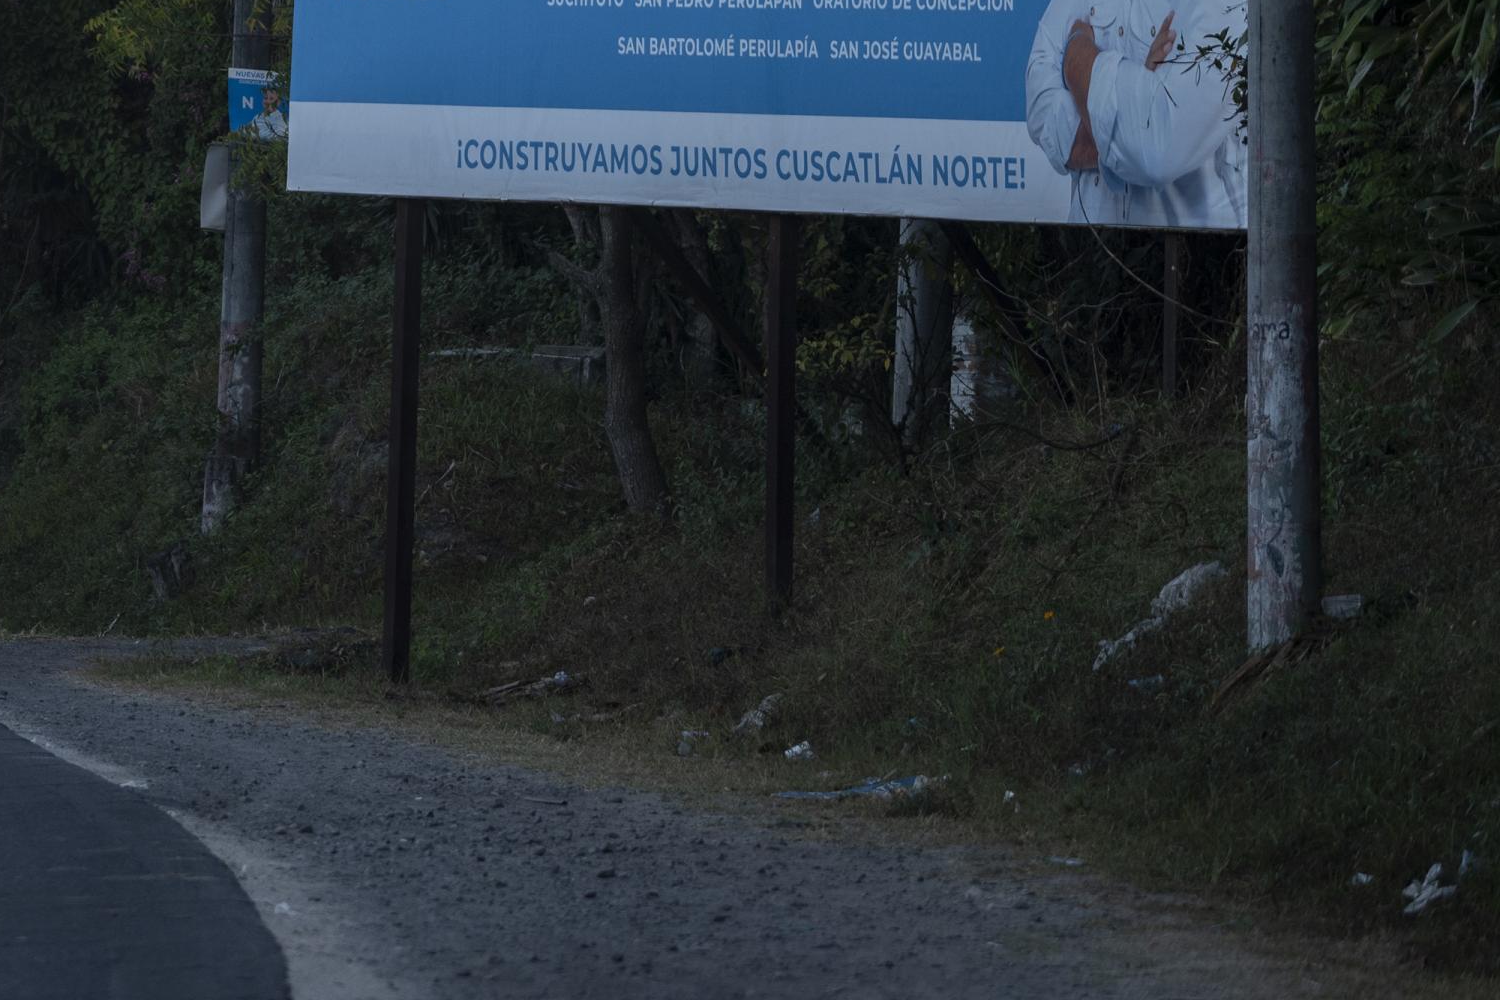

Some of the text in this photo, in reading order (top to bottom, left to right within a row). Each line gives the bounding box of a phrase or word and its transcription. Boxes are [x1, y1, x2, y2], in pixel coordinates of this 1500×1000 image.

[617, 33, 982, 62] SAN BARTOLOMÉ PERULAPÍA SAN JOSÉ GUAYABAL
[236, 71, 265, 80] NUEVAS
[242, 96, 255, 110] N
[456, 138, 1026, 190] ¡CONSTRUYAMOS JUNTOS CUSCATLÁN NORTE!
